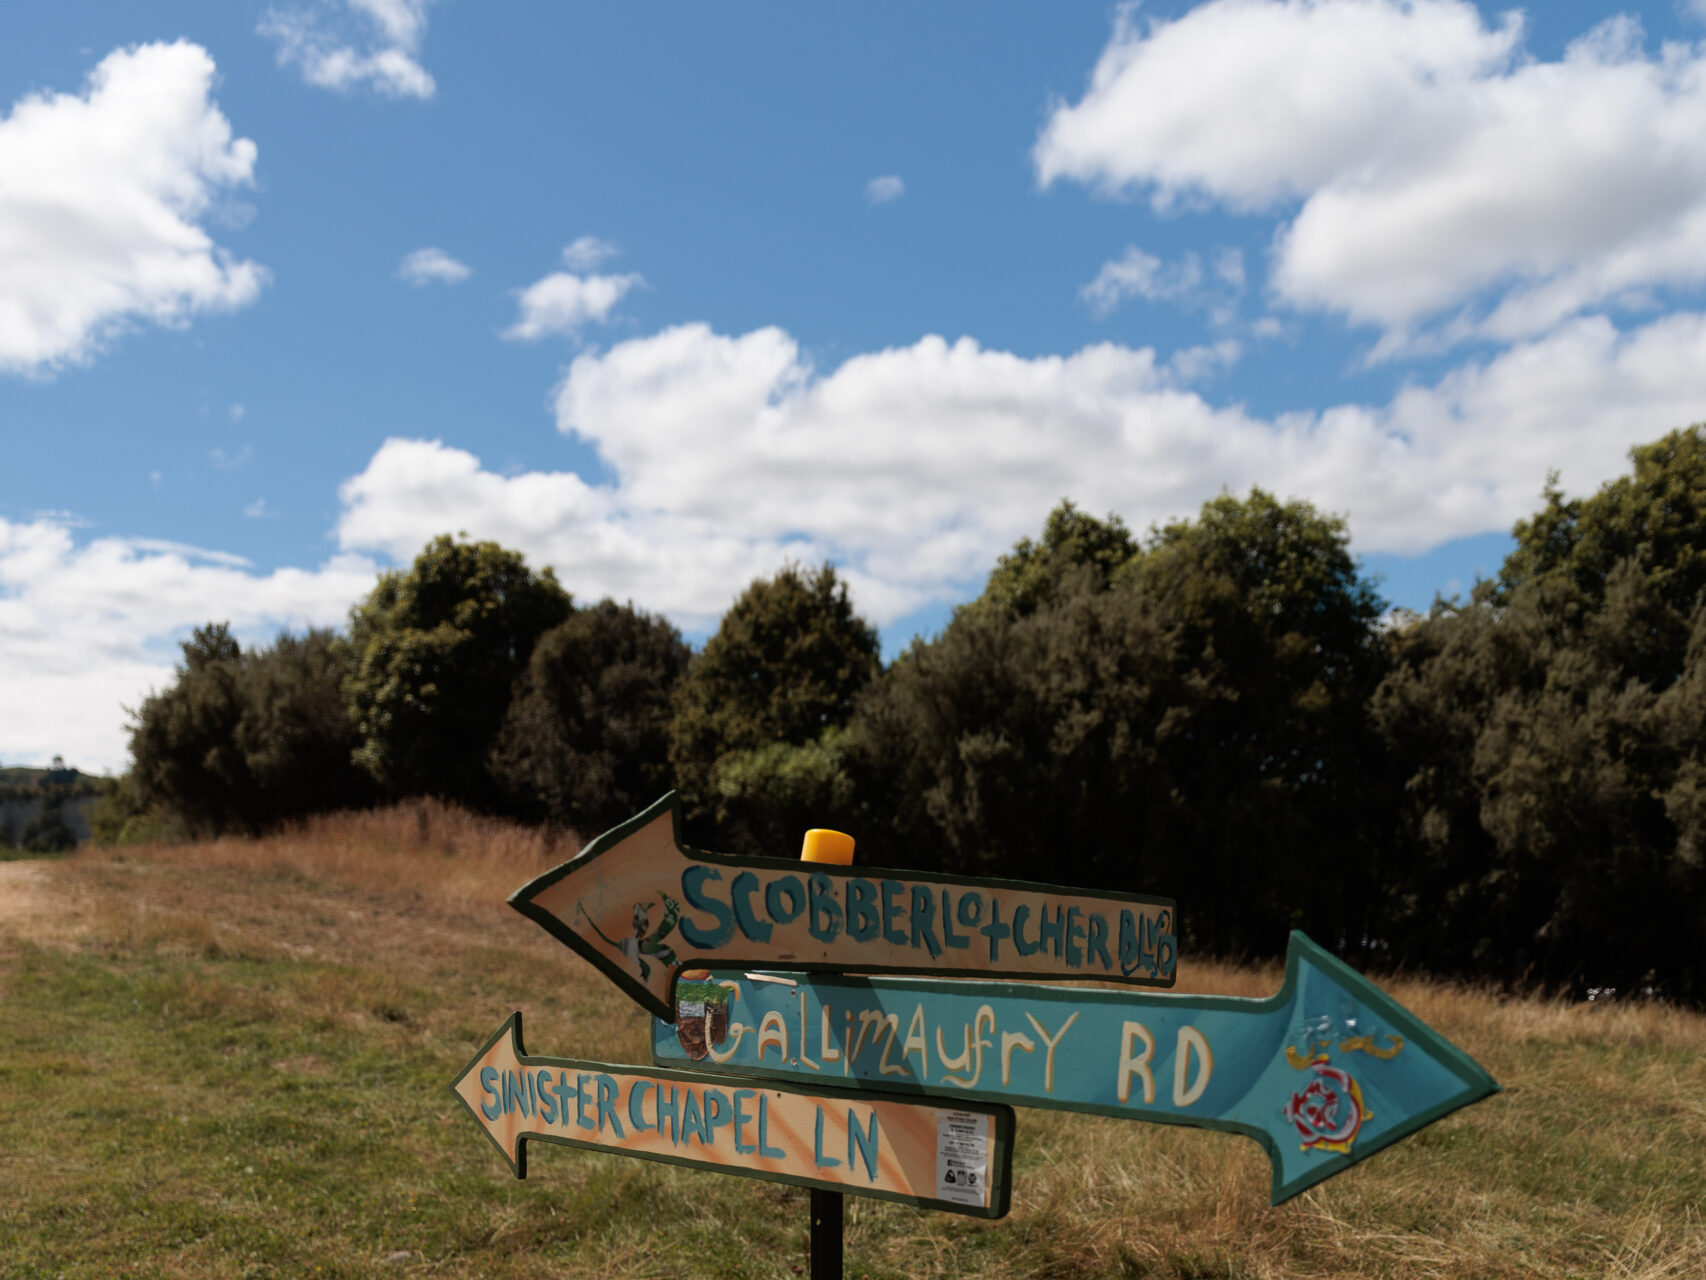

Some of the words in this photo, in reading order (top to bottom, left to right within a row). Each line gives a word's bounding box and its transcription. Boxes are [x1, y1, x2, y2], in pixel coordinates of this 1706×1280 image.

[1117, 1019, 1214, 1107] RD
[628, 1079, 787, 1160] CHAPEL
[814, 1103, 880, 1184] LN
